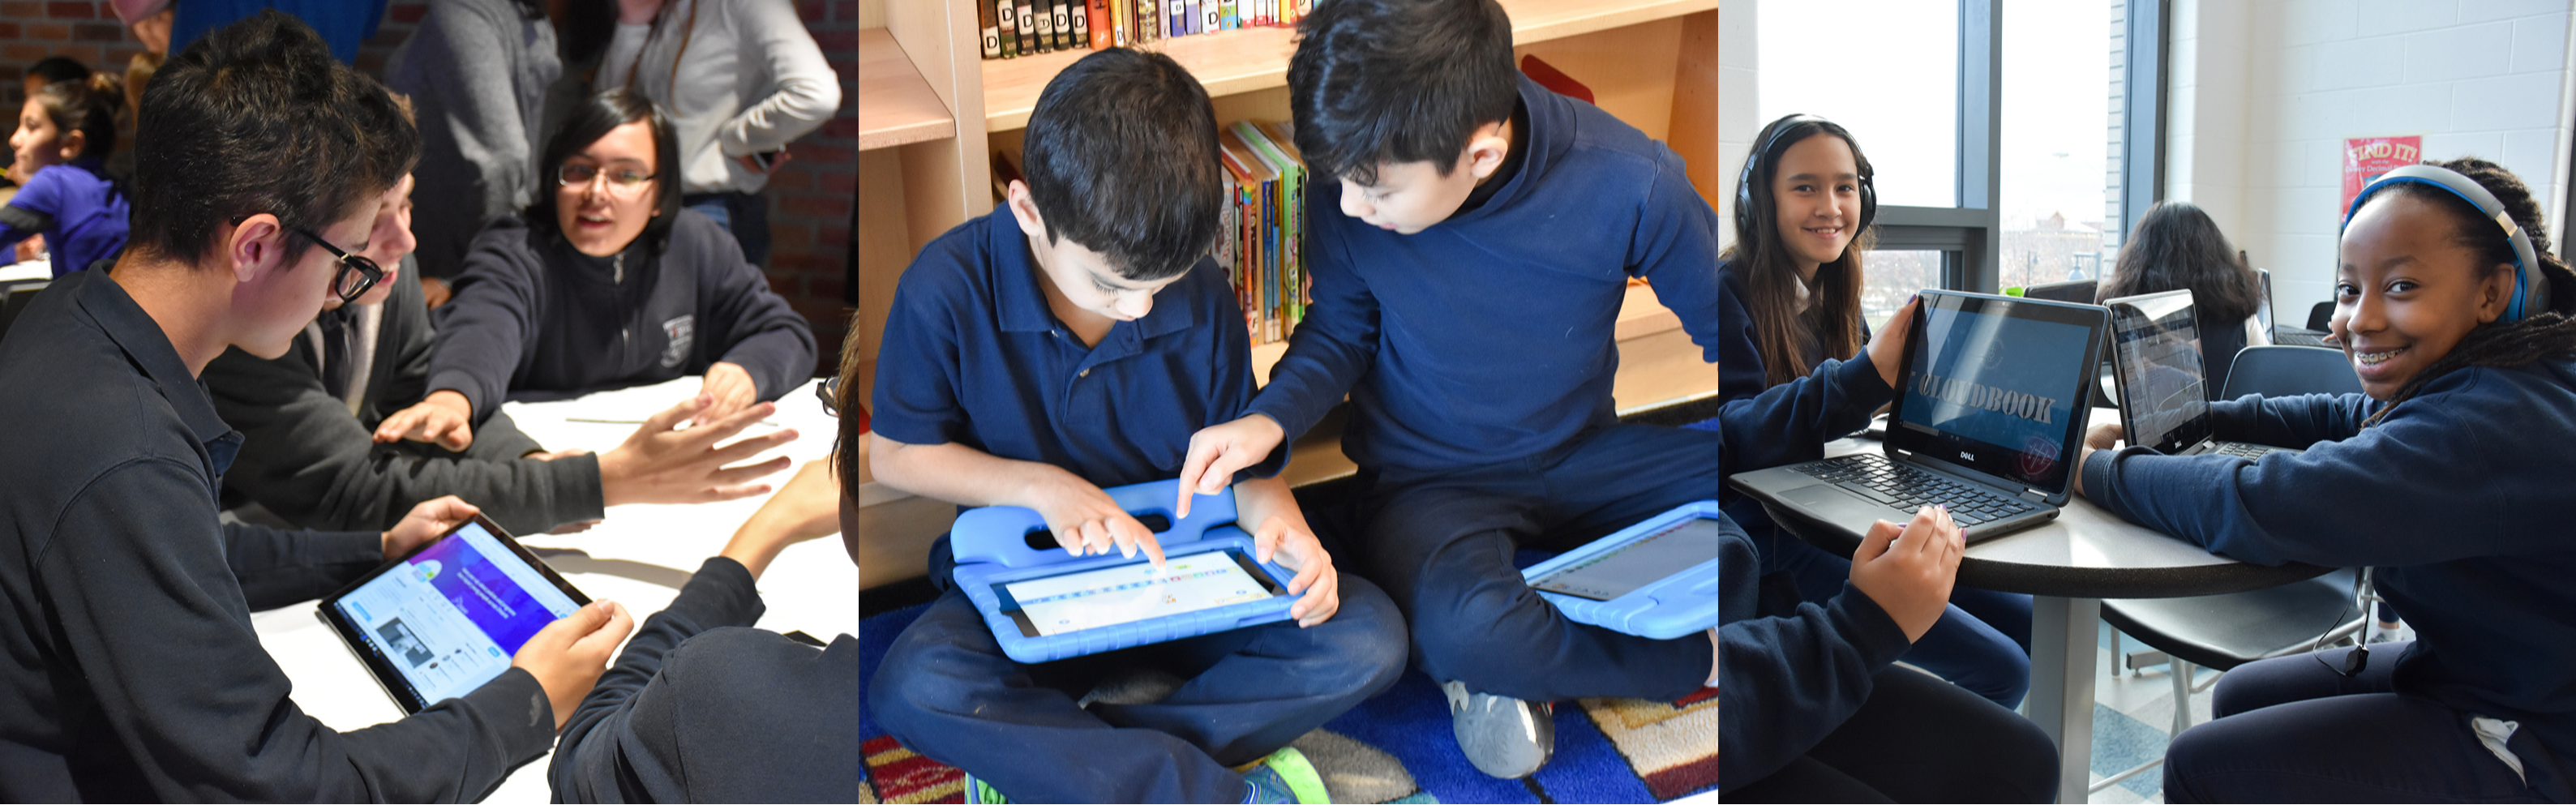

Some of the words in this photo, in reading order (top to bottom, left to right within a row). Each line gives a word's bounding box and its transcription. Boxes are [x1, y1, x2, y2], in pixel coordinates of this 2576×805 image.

[1002, 8, 1013, 21] D
[1056, 14, 1067, 26] D
[1208, 11, 1219, 25] D
[1023, 15, 1033, 28] D
[1074, 15, 1085, 28] D
[987, 36, 997, 49] D
[2347, 143, 2392, 164] FIND
[2393, 143, 2418, 163] IT!
[1918, 373, 2056, 425] CLOUDBOOK
[1960, 451, 1974, 461] DELL
